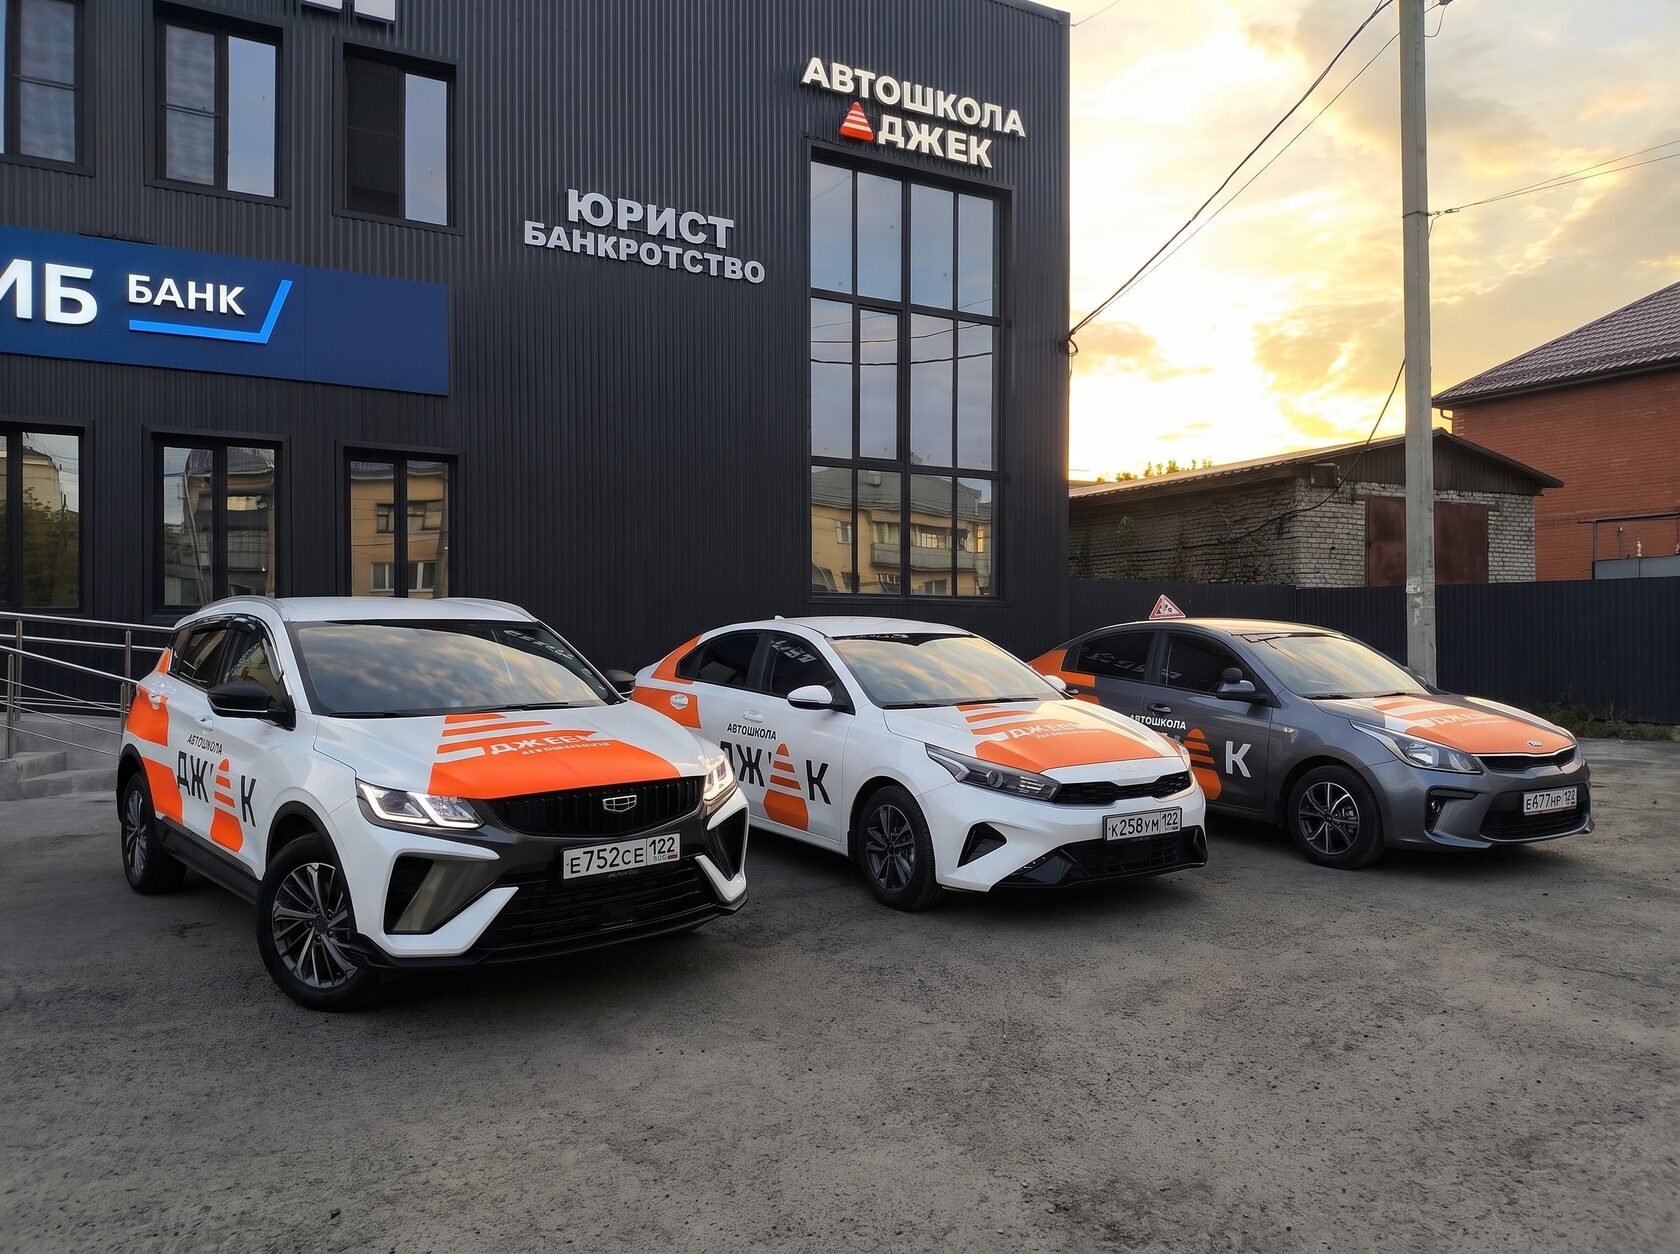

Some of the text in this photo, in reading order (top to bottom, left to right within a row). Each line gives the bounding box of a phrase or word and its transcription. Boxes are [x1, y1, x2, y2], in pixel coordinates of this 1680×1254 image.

[800, 56, 1027, 138] АВТОШКОЛА
[876, 113, 993, 170] ДЖЕК
[566, 188, 735, 249] ЮРИСТ
[524, 220, 766, 284] БАНКРОТСТВО
[127, 273, 246, 317] БАНК
[726, 722, 777, 741] АВТОШКОЛА
[648, 836, 676, 856] 122
